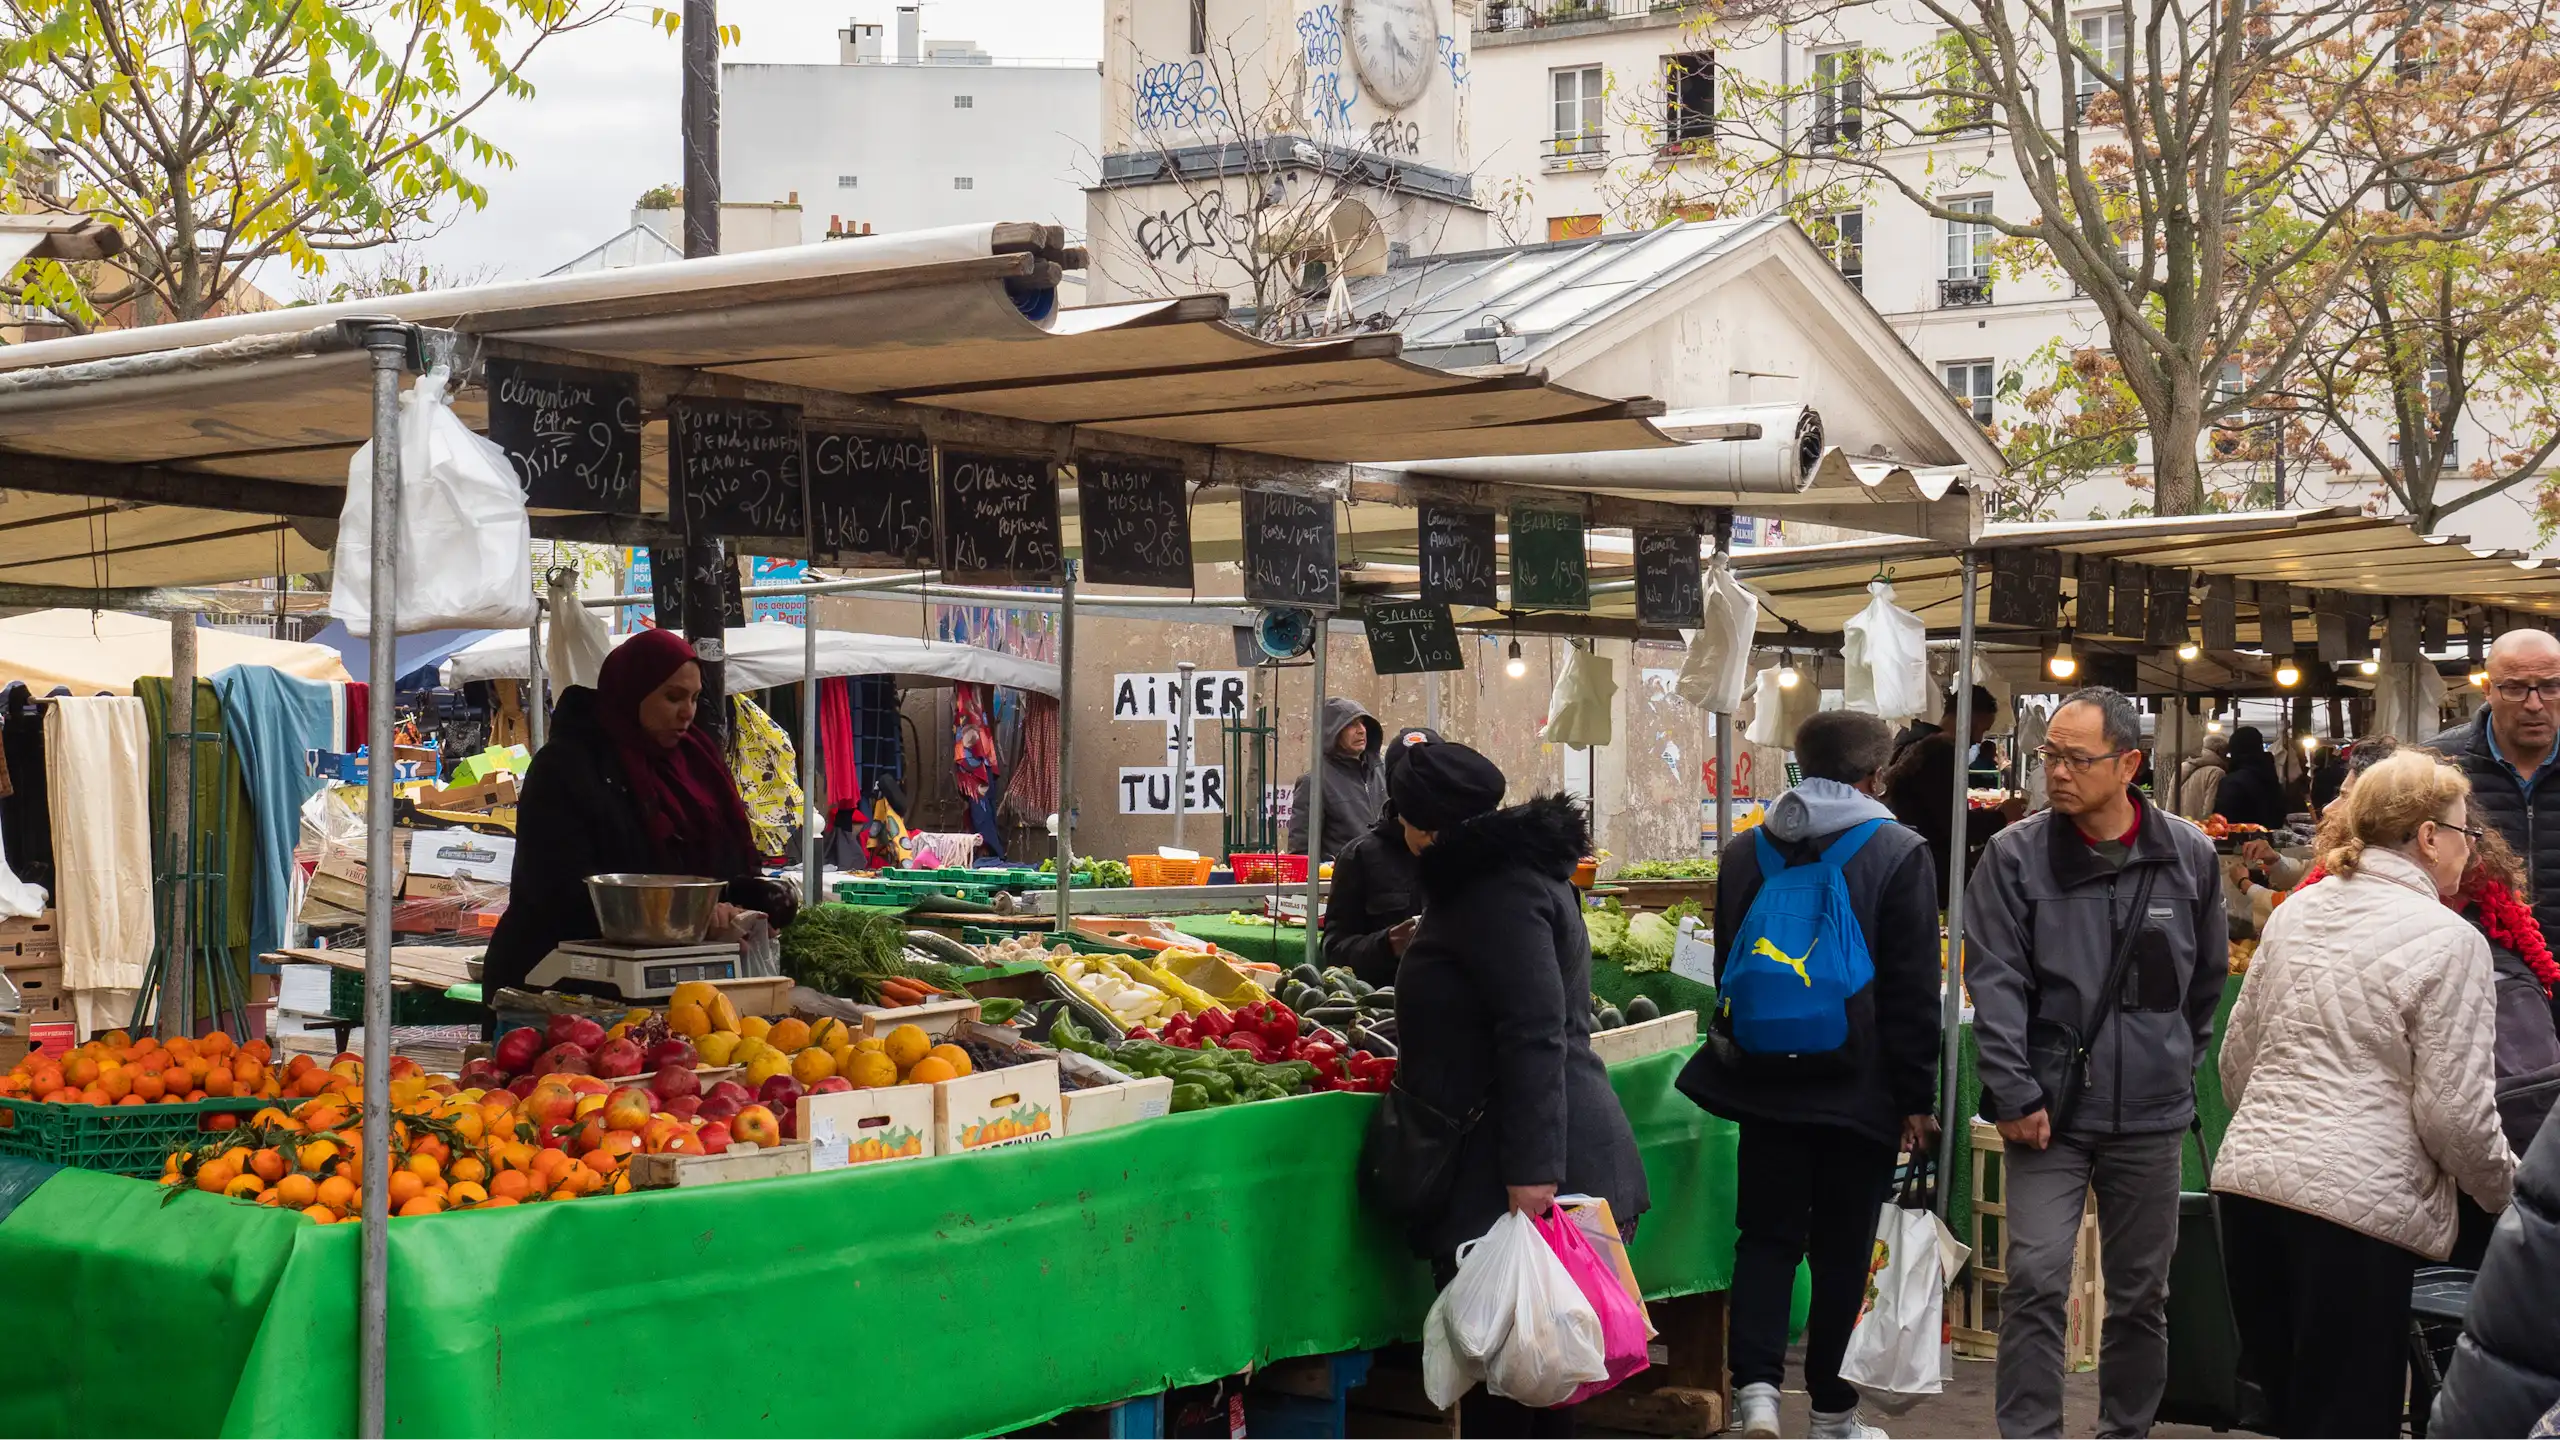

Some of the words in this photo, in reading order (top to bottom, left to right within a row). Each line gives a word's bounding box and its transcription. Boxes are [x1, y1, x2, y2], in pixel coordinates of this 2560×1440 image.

[816, 435, 932, 476] GRENADE
[877, 492, 932, 553] 1,50
[955, 532, 987, 571] Kilo
[1255, 553, 1281, 586] Kilo
[1291, 553, 1329, 596] 1,95
[755, 600, 768, 610] les
[1376, 607, 1435, 625] SALADE
[1121, 768, 1225, 812] TUER
